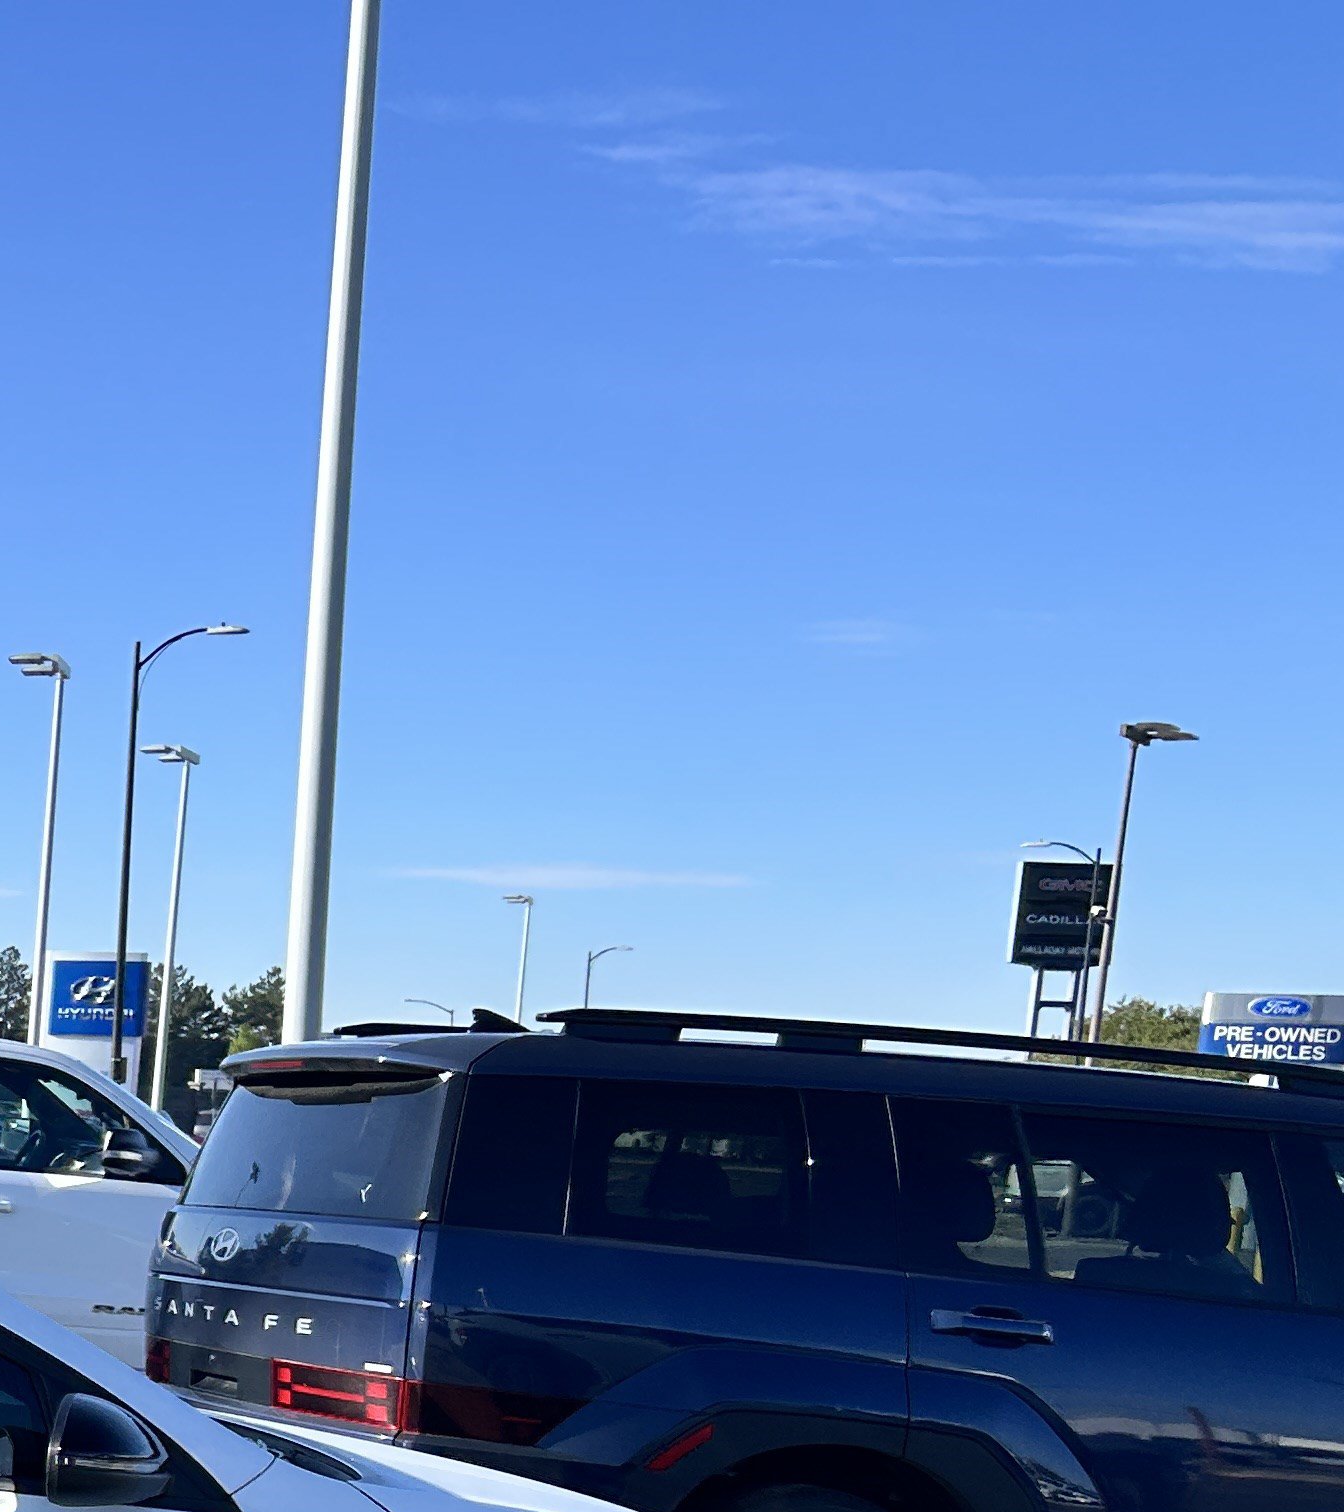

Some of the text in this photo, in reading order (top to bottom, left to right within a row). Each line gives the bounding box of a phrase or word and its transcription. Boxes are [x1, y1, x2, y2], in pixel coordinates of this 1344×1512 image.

[1261, 1000, 1301, 1015] Ford
[1226, 1044, 1325, 1060] VEHICLES
[154, 1297, 312, 1335] SANTA FE
